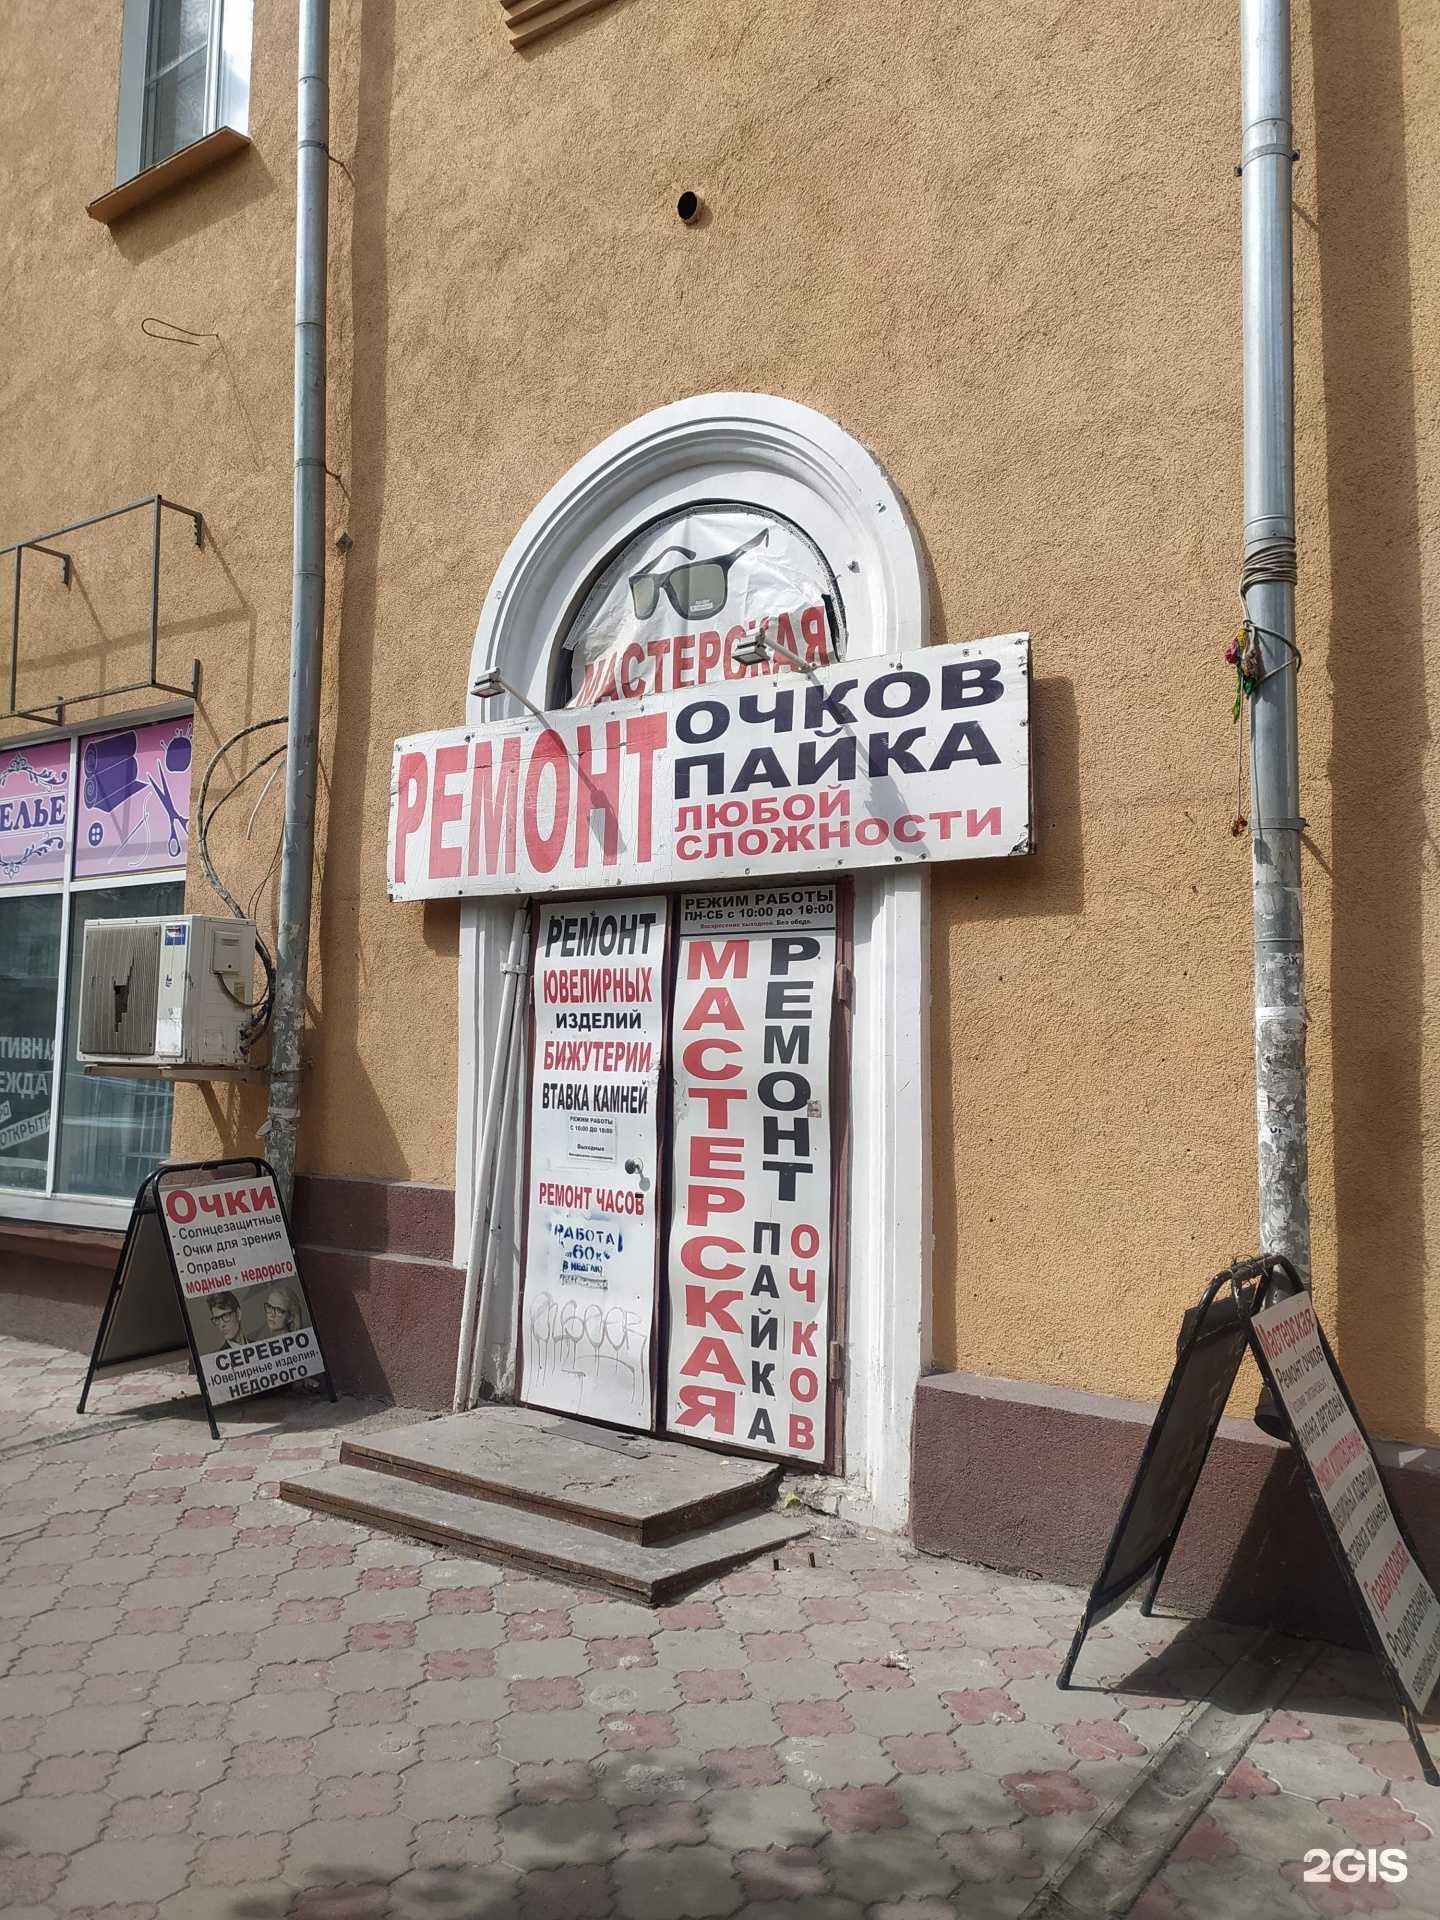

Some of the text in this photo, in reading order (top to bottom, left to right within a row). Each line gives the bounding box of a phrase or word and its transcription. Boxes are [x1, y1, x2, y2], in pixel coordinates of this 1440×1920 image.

[675, 659, 1004, 744] ОЧКОВ
[675, 721, 1002, 799] ПАЙКА
[0, 795, 66, 832] ЕЛЬЕ
[395, 712, 667, 884] РЕМОНТ
[675, 784, 850, 833] ЛЮБОЙ
[676, 807, 1001, 860] СЛОЖНОСТИ
[684, 909, 723, 921] ПН-СБ
[740, 907, 773, 918] 10:00
[777, 908, 793, 917] до
[685, 890, 833, 910] РЕЖИМ РАБОТЫ
[545, 912, 656, 957] РЕМОНТ
[543, 967, 653, 1004] ЮВЕЛИРНЫХ
[556, 1009, 642, 1032] ИЗДЕЛИЙ
[544, 1040, 652, 1073] БИЖУТЕРИИ
[758, 937, 821, 1201] РЕМОНТ
[542, 1080, 648, 1114] ВТАВКА КАМНЕЙ
[166, 1185, 276, 1224] Очки
[539, 1183, 645, 1216] РЕМОНТ ЧАСОВ
[674, 939, 750, 1435] МАСТЕРСКАЯ
[179, 1214, 282, 1241] Солнцезащитные
[183, 1230, 282, 1258] Очки для зрения
[186, 1260, 293, 1294] модные недорого
[187, 1257, 236, 1275] Оправы
[748, 1221, 781, 1444] ПАЙКА
[788, 1224, 820, 1450] ОЧКОВ
[1255, 1308, 1314, 1360] Мастерская
[211, 1349, 316, 1386] Ювелирные изделия
[215, 1333, 310, 1371] СЕРЕБРО
[229, 1365, 308, 1399] НЕДОРОГО
